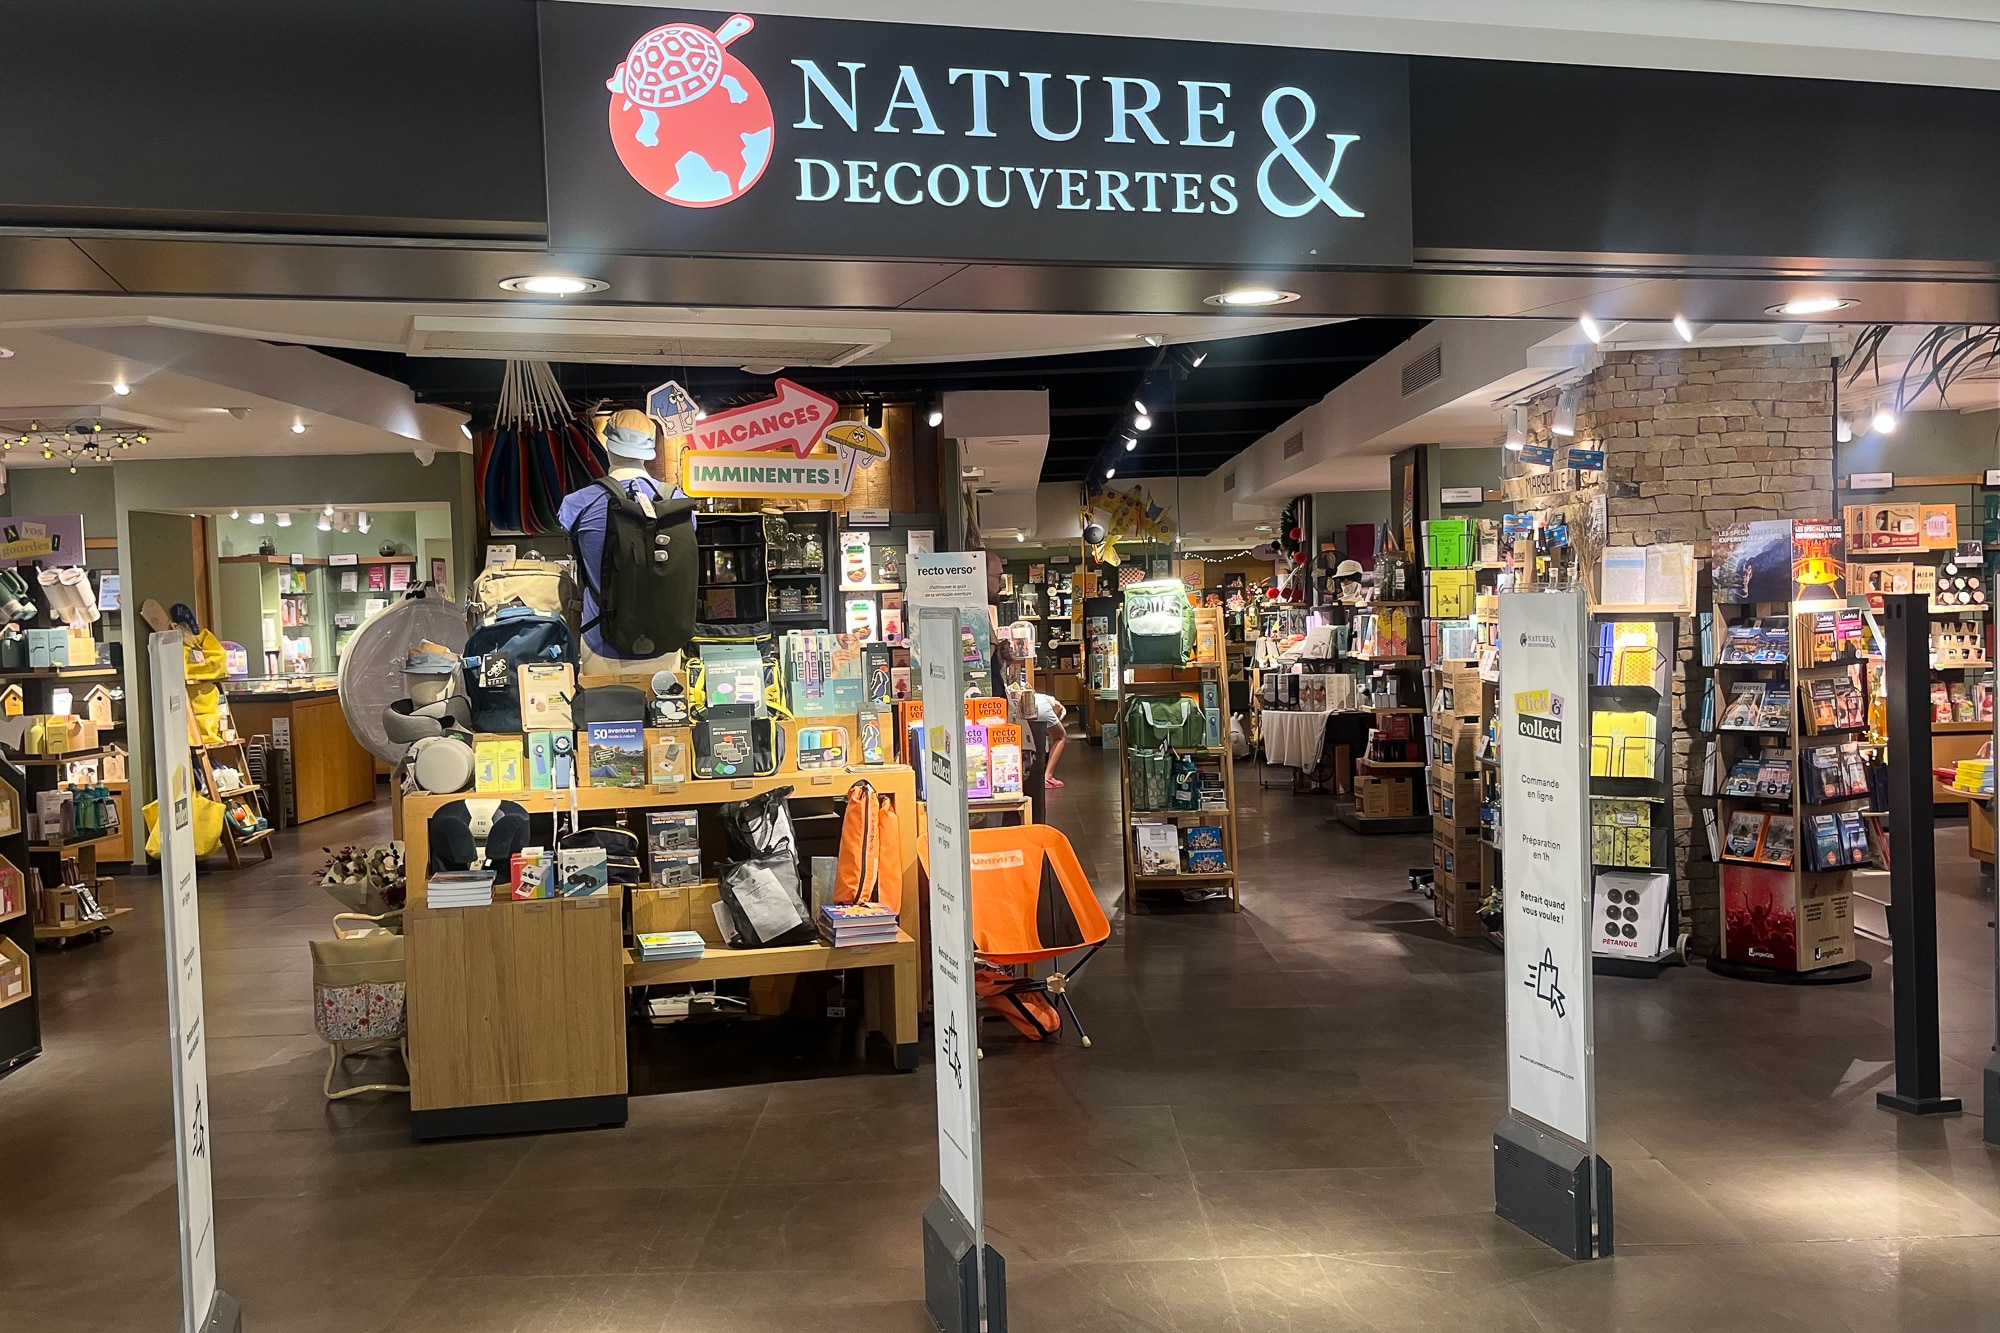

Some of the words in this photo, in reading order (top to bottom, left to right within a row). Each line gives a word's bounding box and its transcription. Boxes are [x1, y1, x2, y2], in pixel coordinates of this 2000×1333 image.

[792, 58, 1237, 150] NATURE
[1257, 86, 1366, 219] &
[794, 158, 1240, 216] DECOUVERTES
[699, 404, 821, 450] VACANCES
[694, 465, 830, 485] IMMINENTES
[834, 468, 840, 485] !
[1526, 472, 1565, 494] MARSEILLE
[24, 526, 43, 536] vos
[3, 541, 50, 557] gourdes
[917, 566, 944, 576] recto
[1516, 693, 1548, 713] Click
[1551, 698, 1562, 716] &
[593, 728, 608, 740] 50
[965, 729, 982, 737] ecto
[992, 729, 1016, 737] recto
[1520, 719, 1561, 742] collect
[1521, 774, 1560, 789] Commande
[1527, 790, 1536, 799] en
[1537, 790, 1554, 802] ligne
[1522, 834, 1561, 850] Préparation
[971, 855, 1017, 865] UMMIT
[1533, 851, 1541, 859] en
[1542, 852, 1550, 861] 1h
[1520, 890, 1543, 904] Retrait
[1543, 898, 1566, 911] quand
[1522, 906, 1538, 917] vous
[1538, 908, 1560, 923] voulez
[1602, 938, 1638, 949] PÉTANQUE
